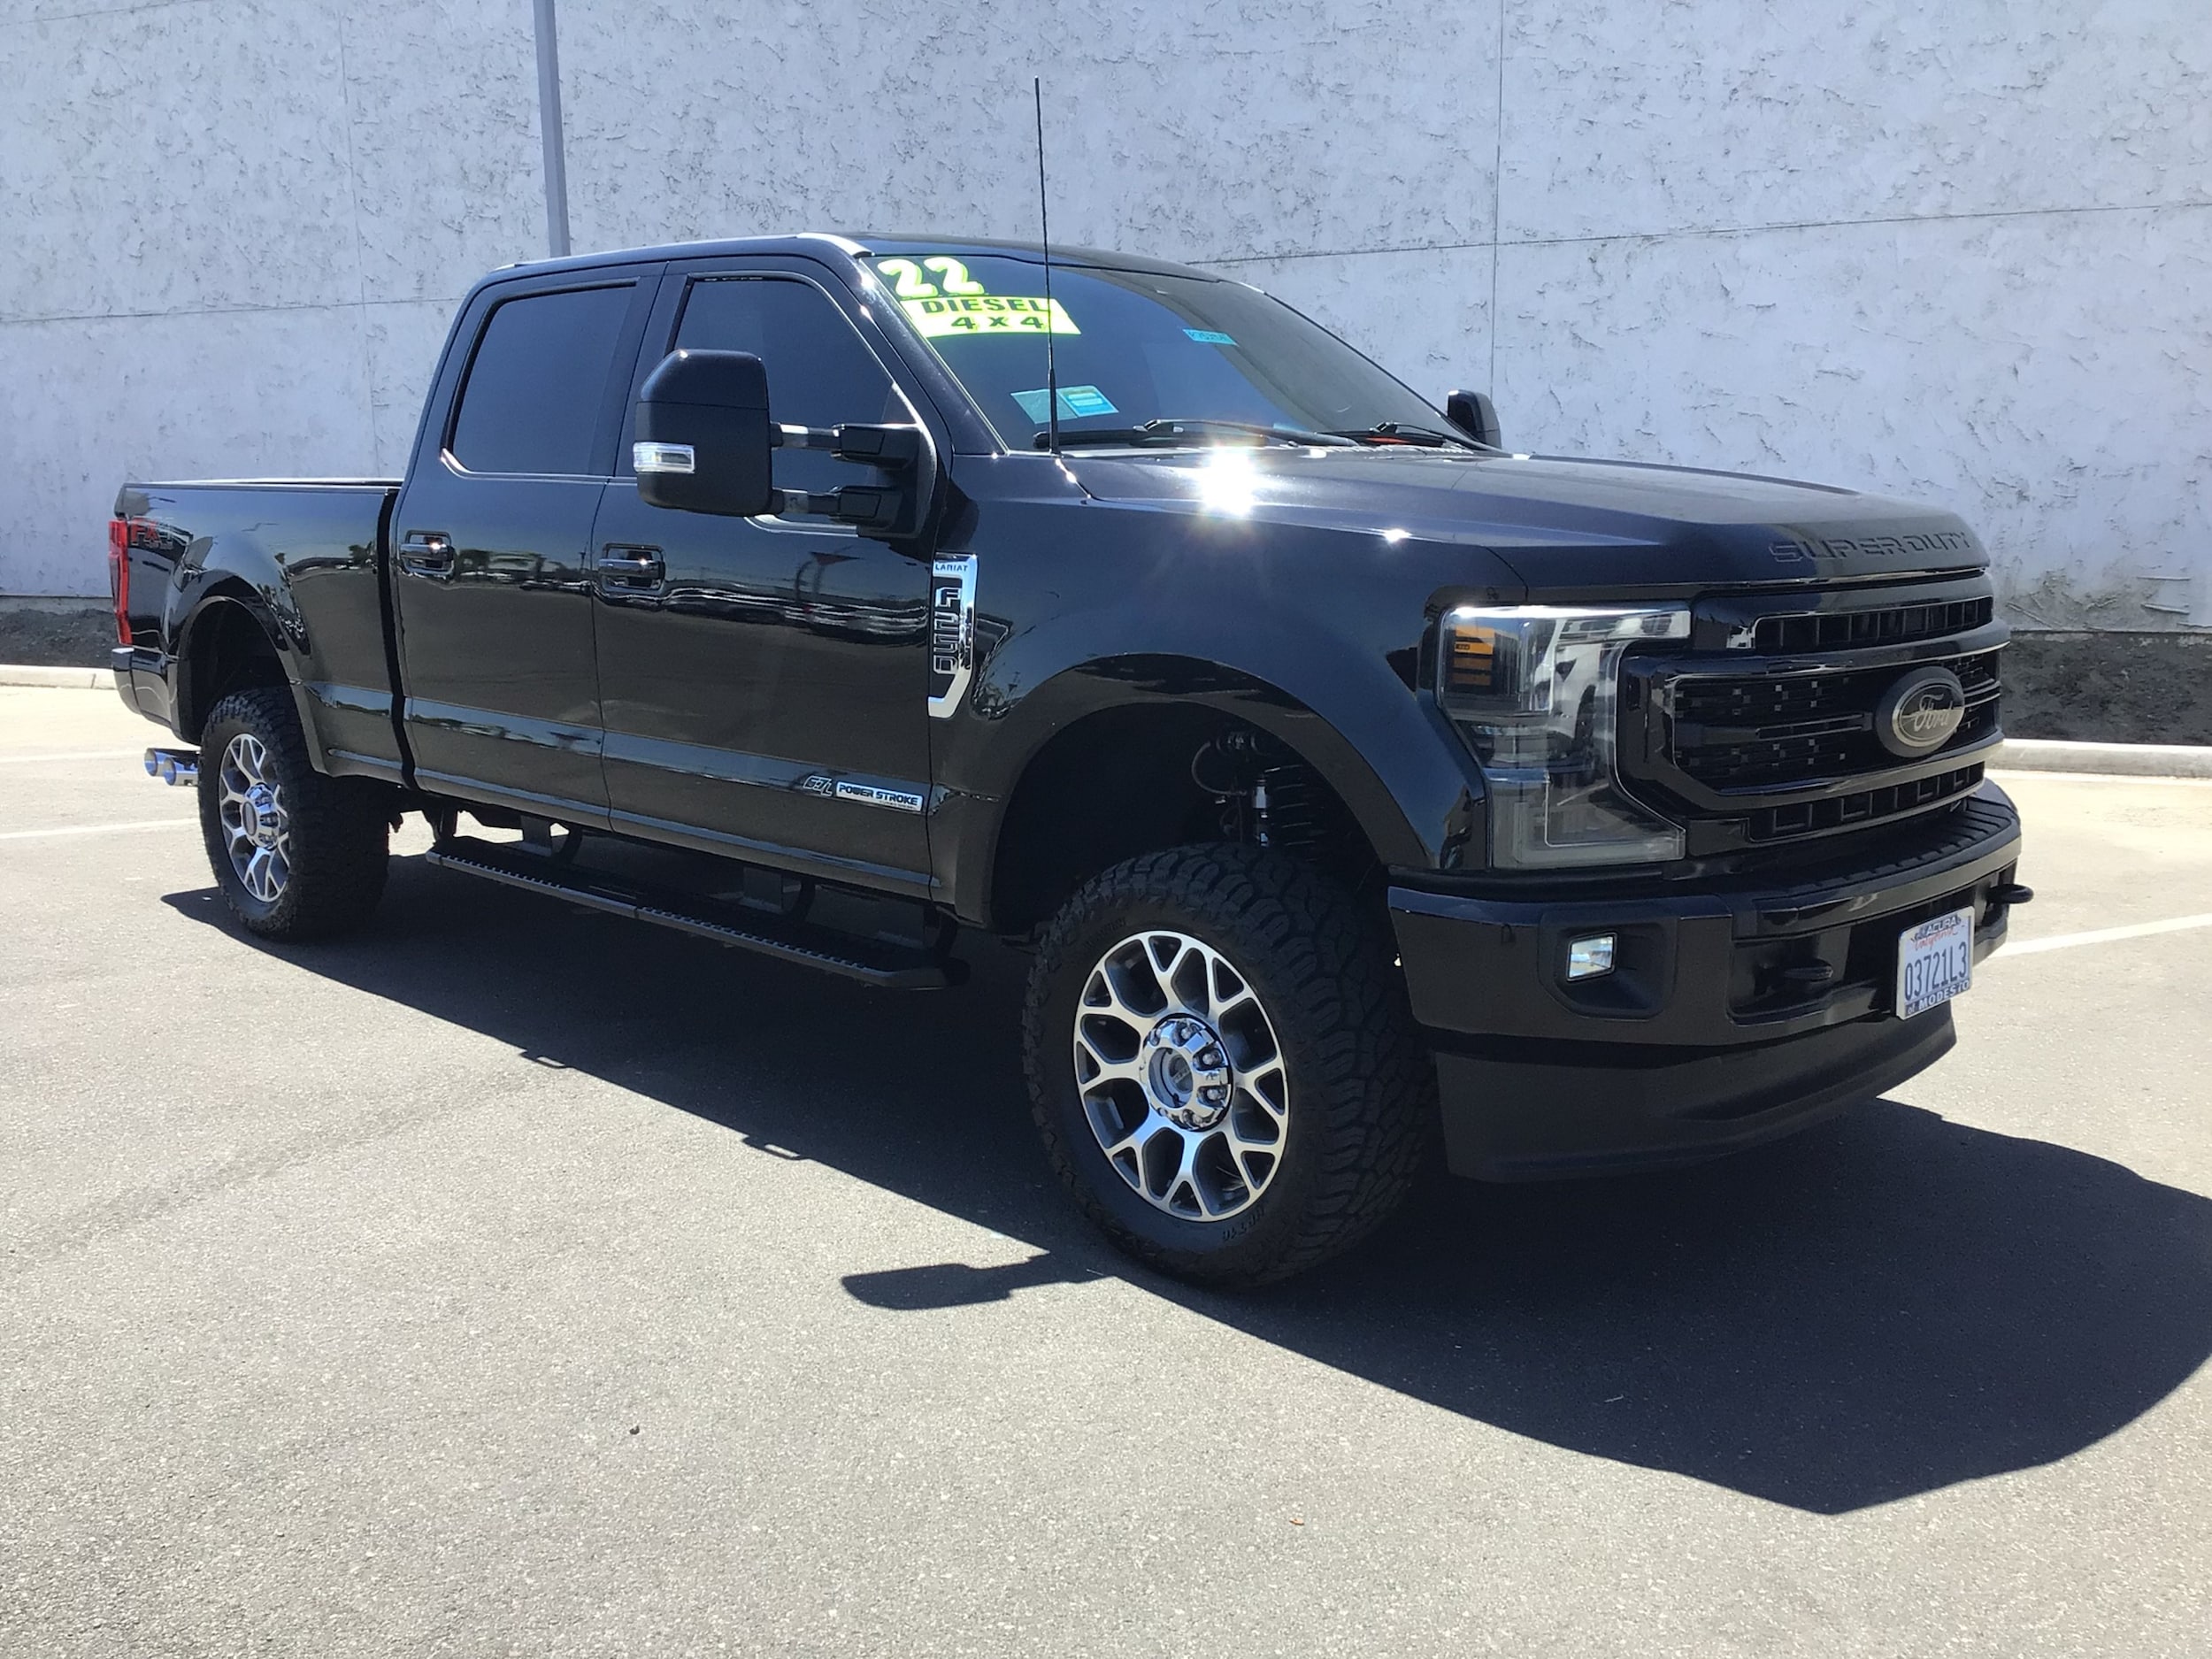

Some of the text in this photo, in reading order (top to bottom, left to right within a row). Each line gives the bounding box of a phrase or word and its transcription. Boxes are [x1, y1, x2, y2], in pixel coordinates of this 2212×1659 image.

[877, 257, 985, 298] 22
[920, 297, 1050, 314] DIESEL
[935, 563, 968, 572] LARIAT
[1902, 693, 1955, 732] Ford
[838, 784, 874, 799] POWER
[875, 790, 919, 806] STROKE
[1905, 941, 1967, 1001] 03721L3
[1918, 979, 1970, 1010] MODESTO
